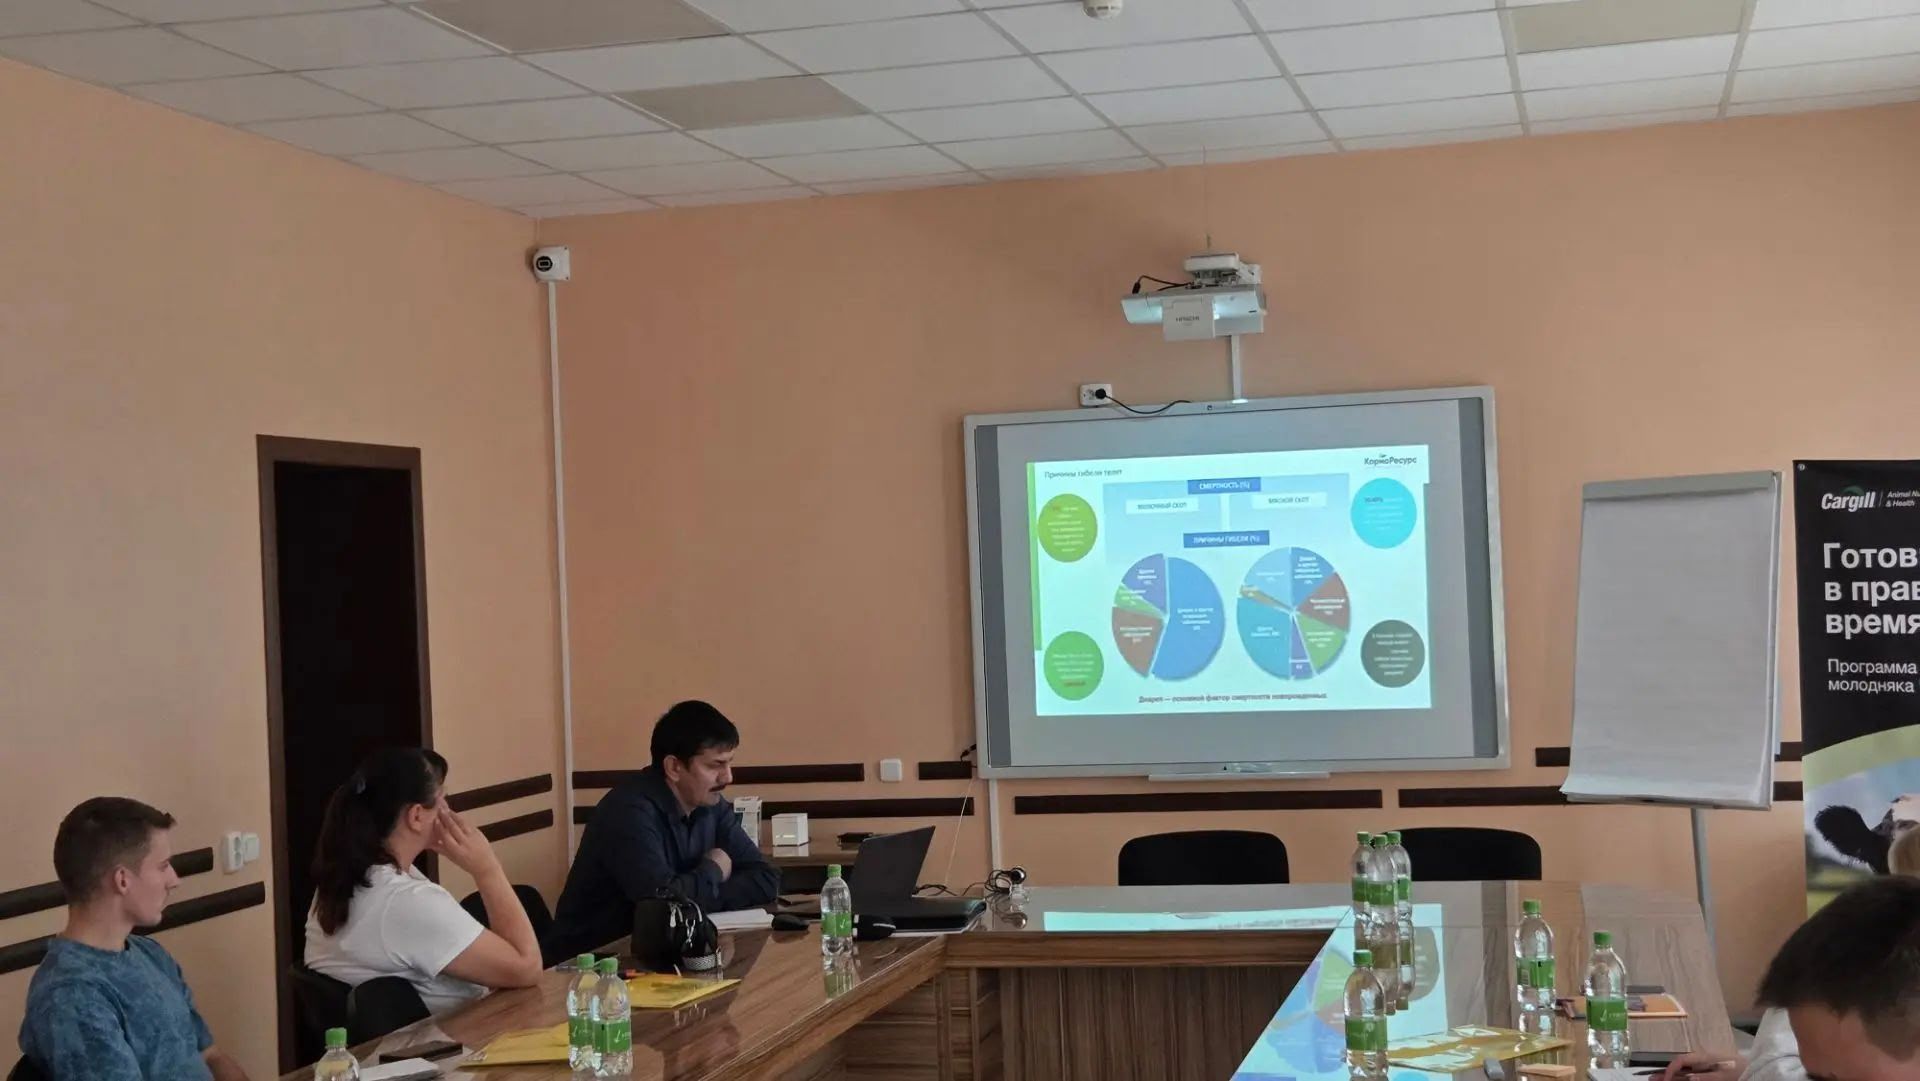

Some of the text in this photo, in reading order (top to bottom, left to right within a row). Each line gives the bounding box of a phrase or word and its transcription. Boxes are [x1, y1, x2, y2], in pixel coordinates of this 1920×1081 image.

[1364, 456, 1417, 466] КормоРесурс
[1821, 491, 1876, 512] Cargill
[1887, 490, 1911, 498] Animal
[1892, 499, 1915, 507] Health
[1824, 542, 1920, 569] Готов
[1825, 582, 1842, 601] в
[1826, 613, 1920, 640] время
[1828, 659, 1918, 676] Программа
[1828, 680, 1915, 693] молодняка
